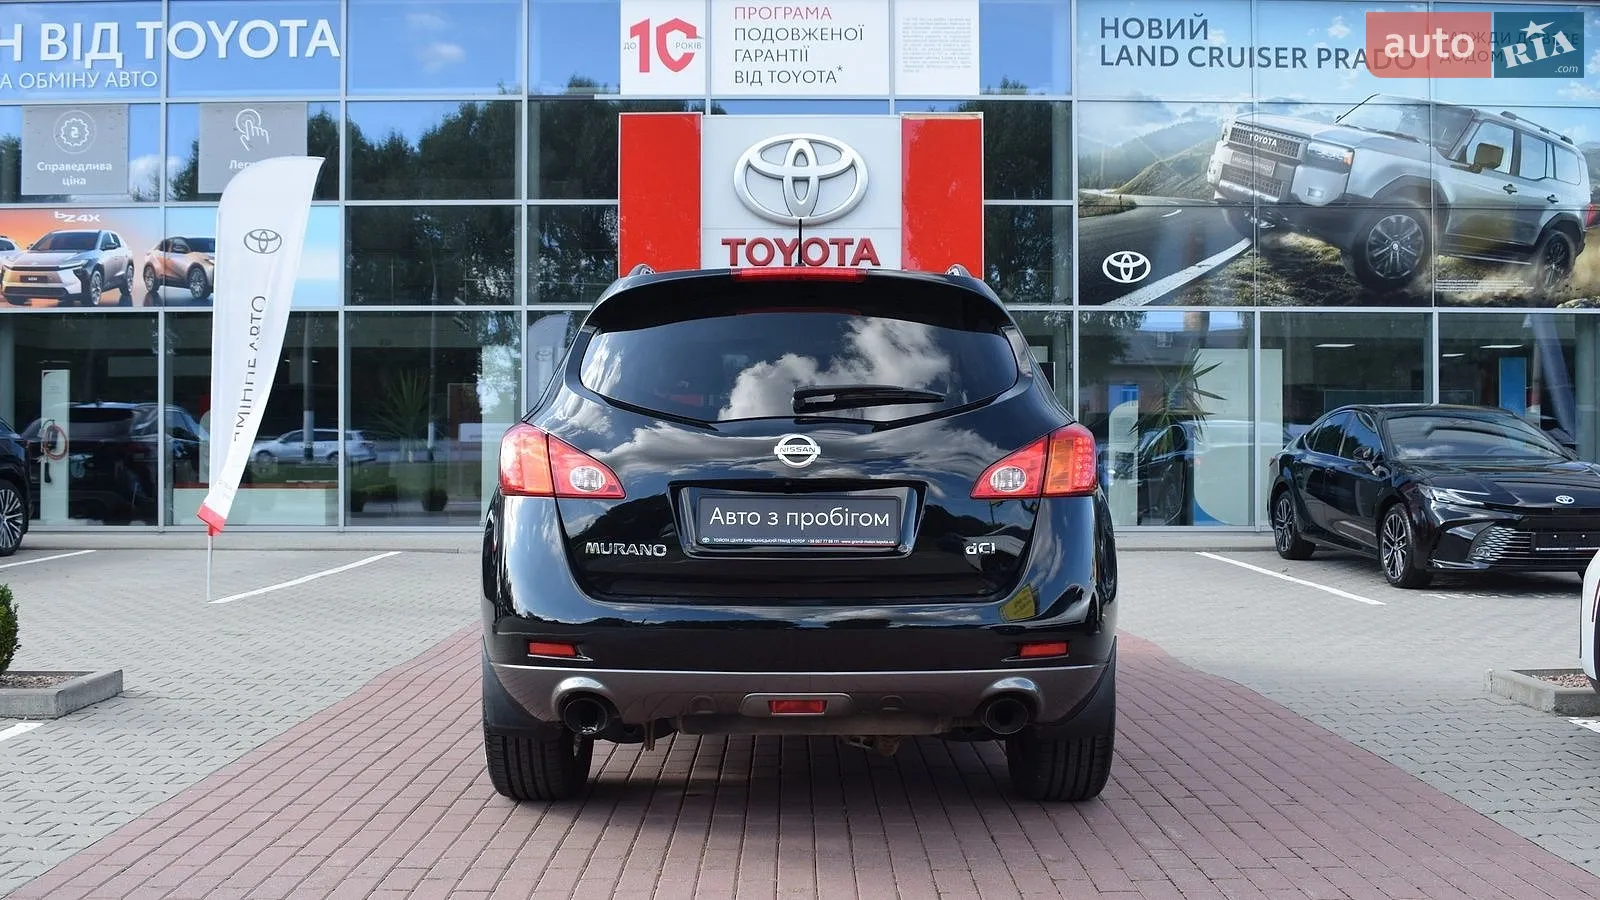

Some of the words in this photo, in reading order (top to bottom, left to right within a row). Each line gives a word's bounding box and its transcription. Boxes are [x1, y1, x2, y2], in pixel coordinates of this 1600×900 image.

[734, 6, 832, 20] ПРОГРАМА
[734, 25, 864, 43] ПОДОВЖЕНОЇ
[1100, 13, 1209, 40] НОВИЙ
[40, 23, 123, 68] ВІД
[136, 19, 341, 60] TOYOTA
[624, 42, 637, 50] ДО
[734, 46, 809, 62] ГАРАНТІЇ
[1100, 46, 1178, 67] LAND
[1187, 46, 1308, 69] CRUISER
[1318, 48, 1416, 70] PRADO
[19, 71, 100, 89] ОБМІНУ
[105, 70, 158, 88] АВТО
[734, 70, 763, 87] ВІД
[1249, 133, 1277, 147] TOYOTA
[37, 161, 113, 174] Справедлива
[62, 175, 87, 187] ціна
[721, 238, 881, 266] TOYOTA
[709, 506, 761, 525] Авто
[767, 511, 779, 526] з
[786, 507, 890, 531] пробігом
[585, 542, 667, 557] MURANO
